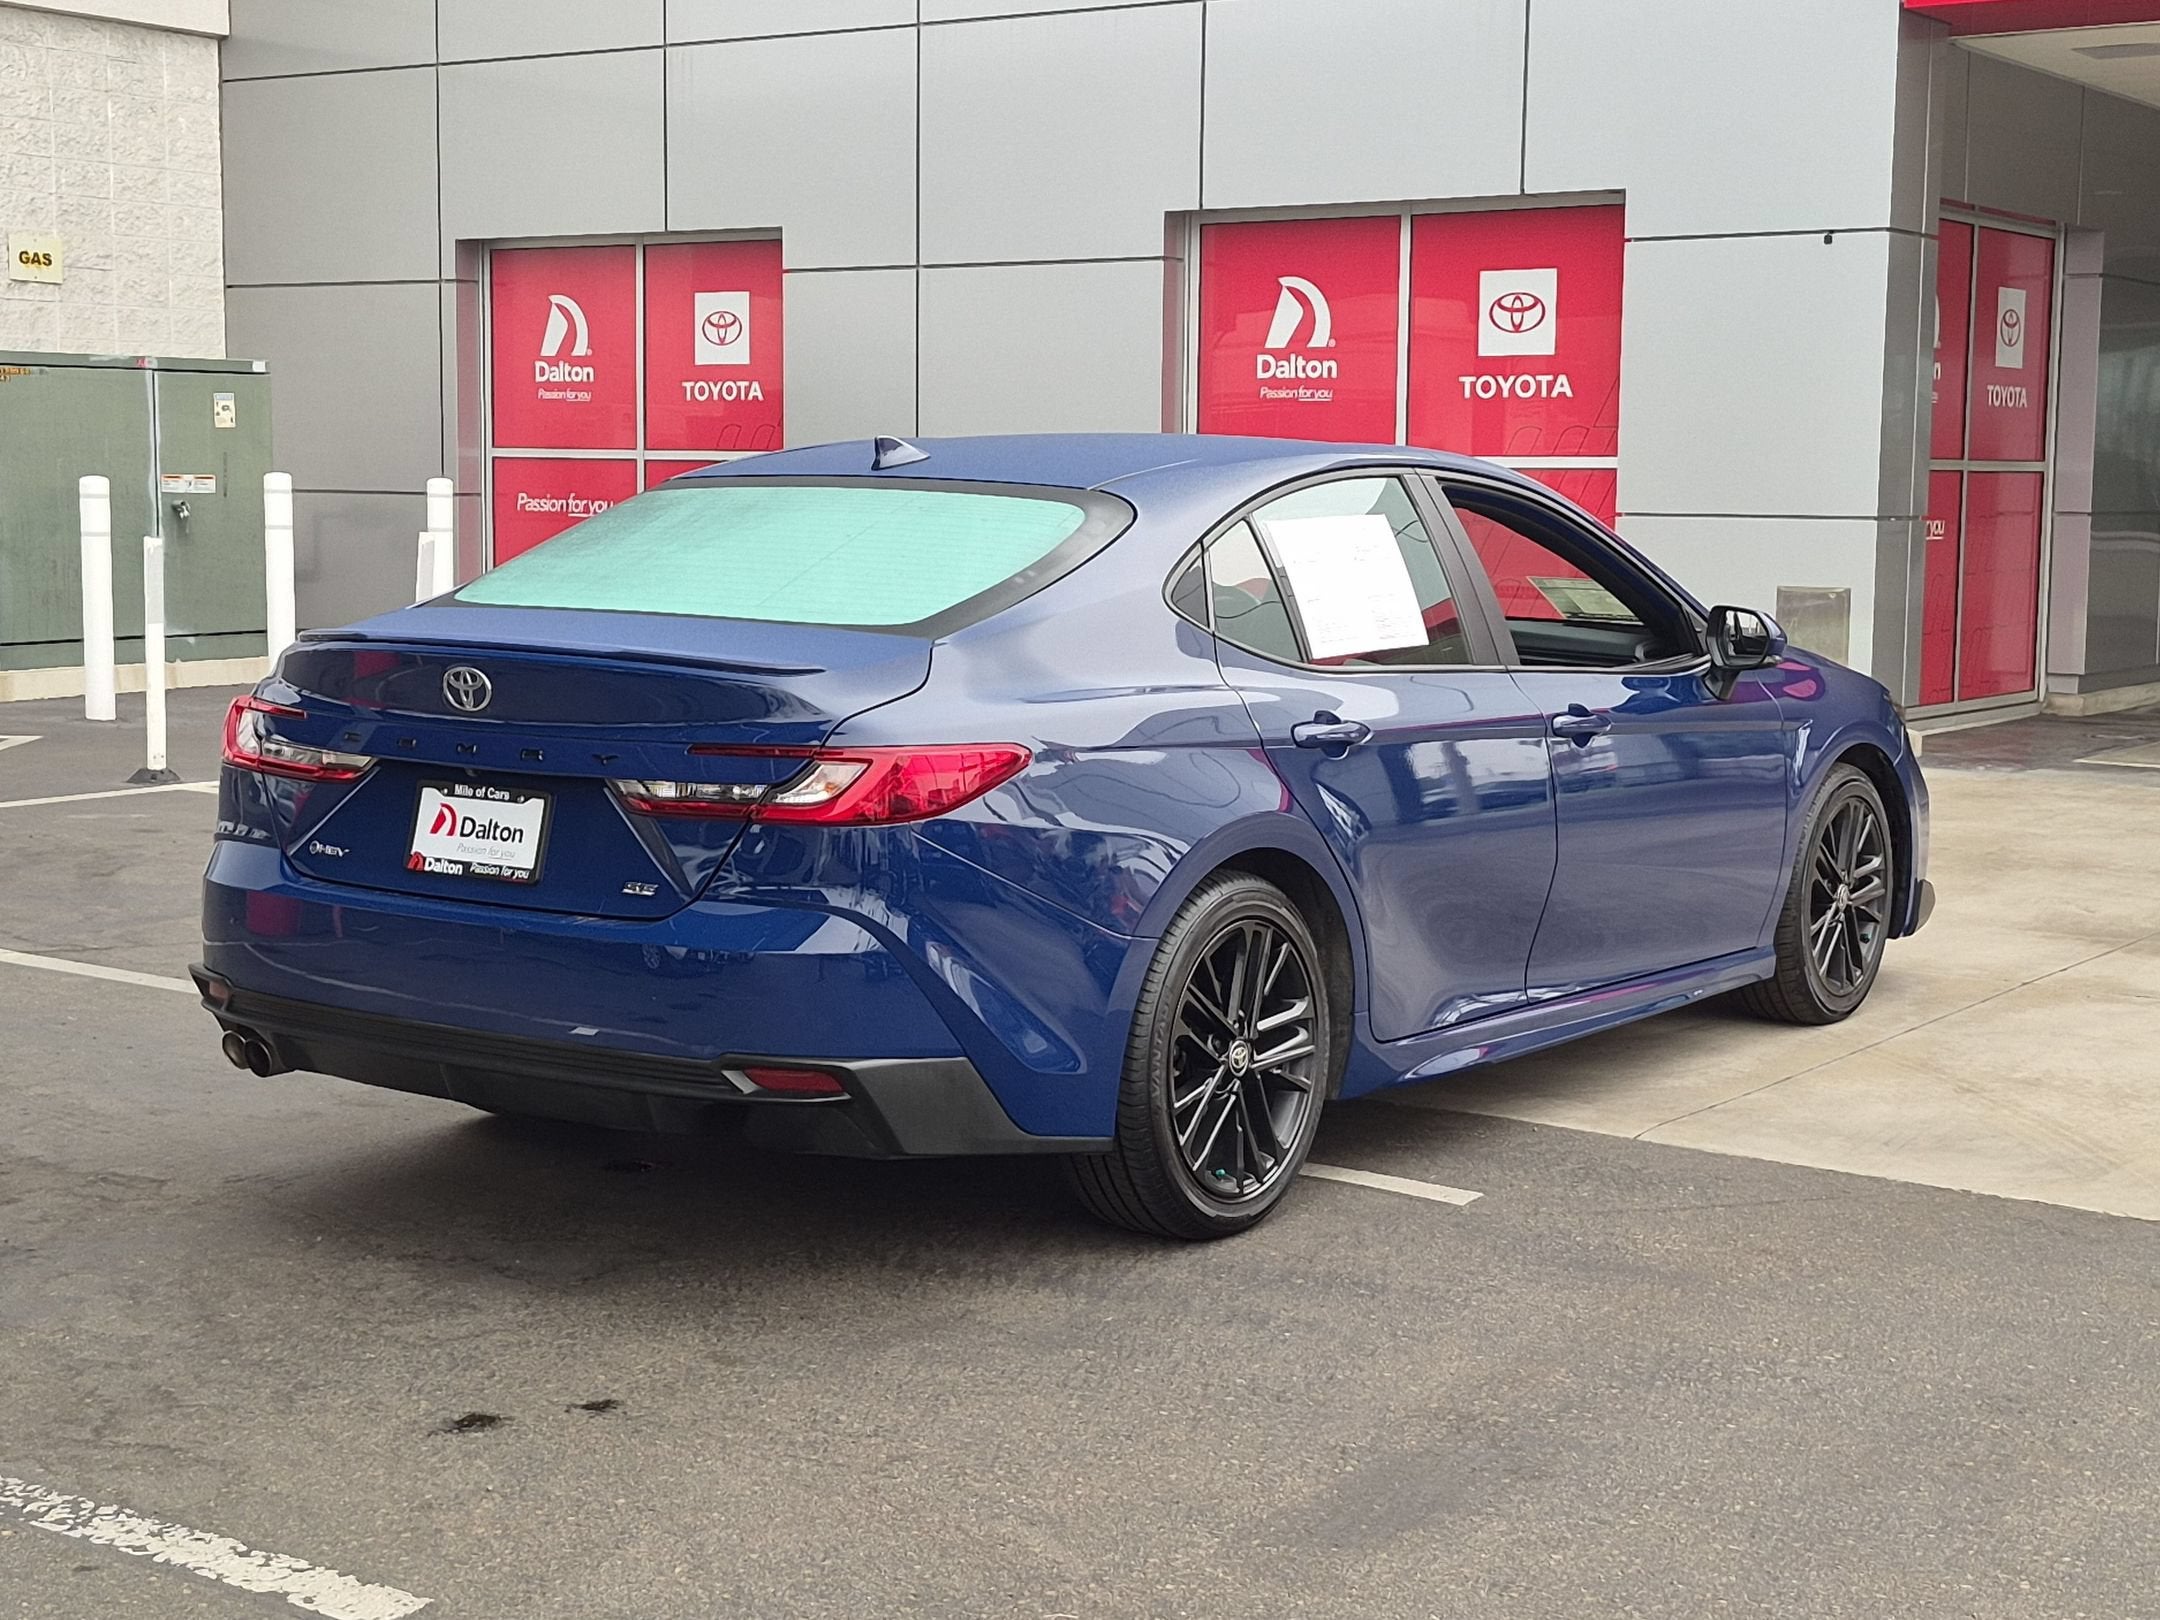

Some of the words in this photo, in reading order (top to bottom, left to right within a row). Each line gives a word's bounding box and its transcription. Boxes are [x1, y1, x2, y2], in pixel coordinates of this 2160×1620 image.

[19, 250, 53, 267] GAS
[534, 360, 595, 382] Dalton
[1257, 353, 1338, 379] Dalton
[682, 381, 764, 401] TOYOTA
[1260, 386, 1298, 399] Passion
[1459, 373, 1573, 398] TOYOTA
[1986, 384, 2028, 408] TOYOTA
[517, 492, 567, 512] Passion
[568, 493, 588, 512] for
[454, 783, 474, 797] Mile
[475, 786, 486, 798] of
[487, 787, 510, 800] Cars
[460, 816, 524, 843] Dalton
[456, 842, 488, 856] Passion
[487, 844, 500, 857] for
[500, 849, 516, 859] you
[424, 857, 463, 875] Dalton
[470, 862, 500, 876] Passion
[500, 865, 514, 877] for
[513, 868, 530, 880] you
